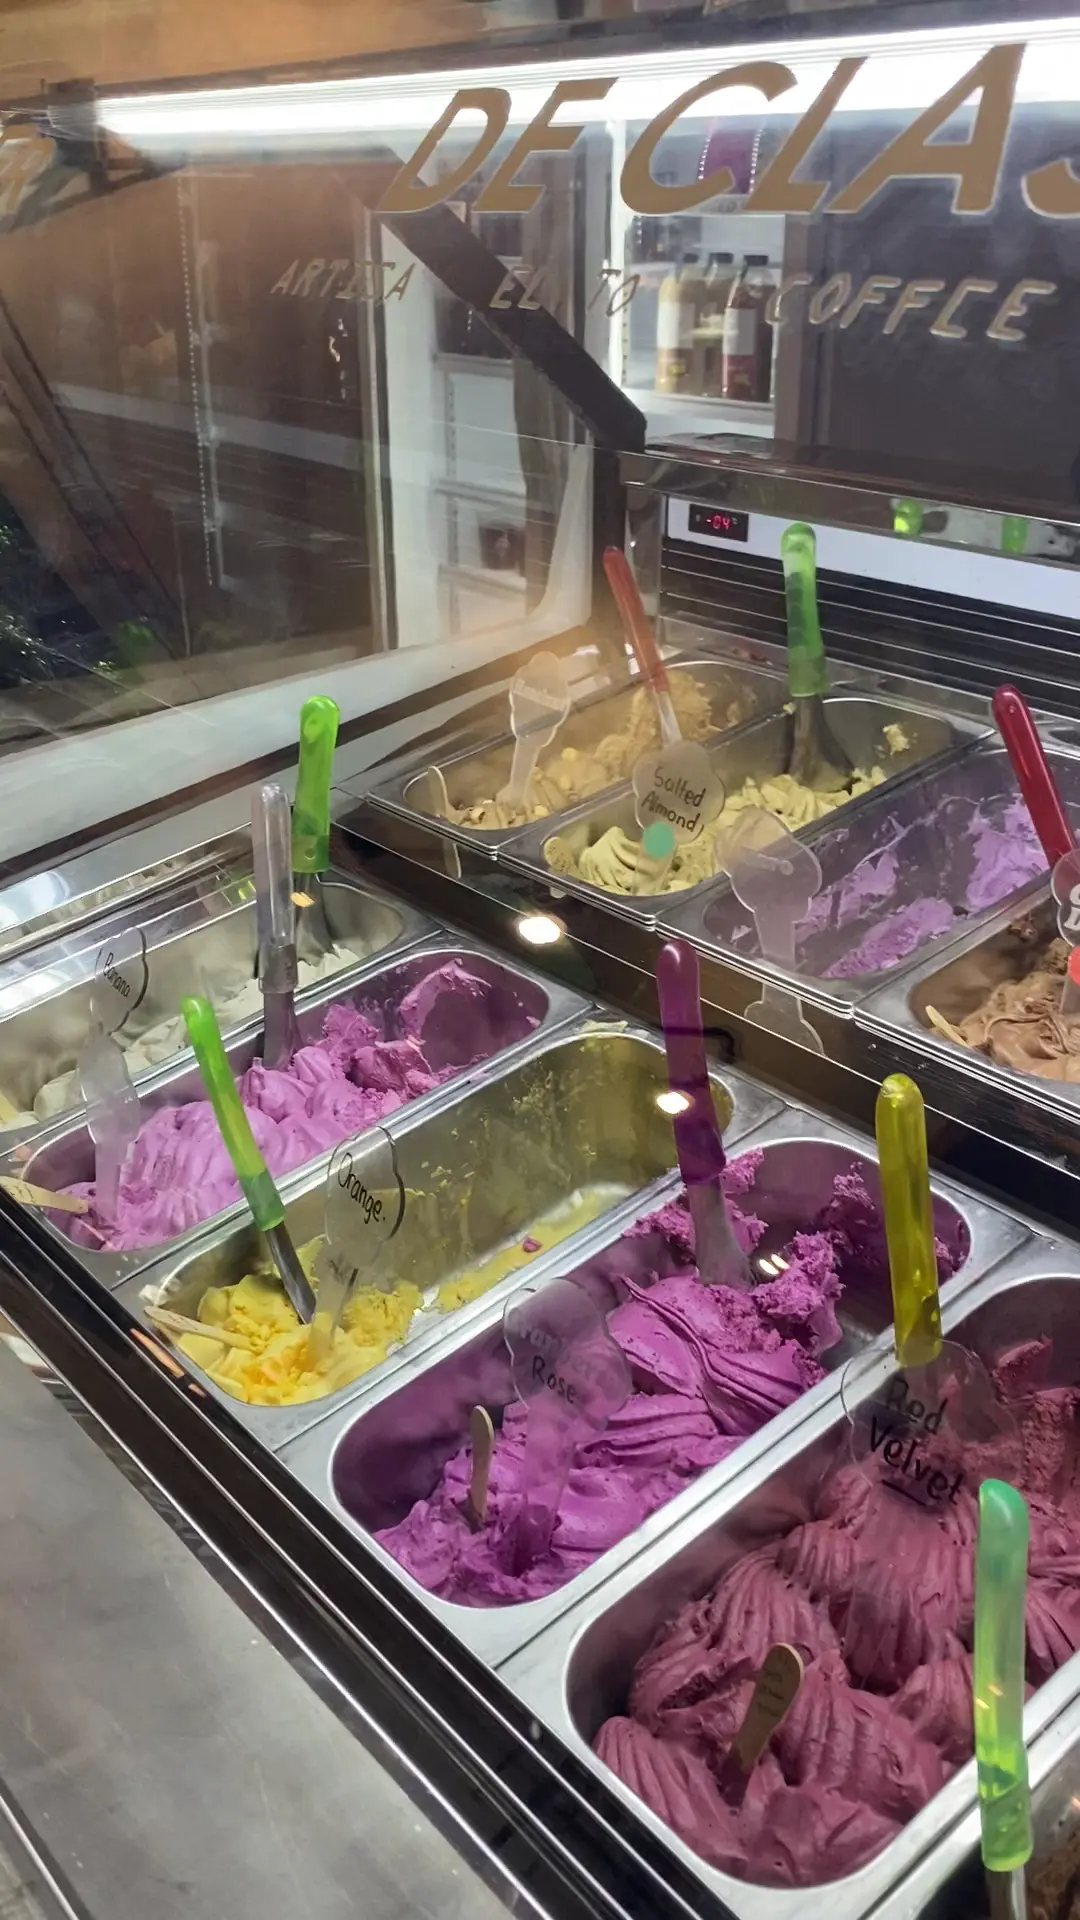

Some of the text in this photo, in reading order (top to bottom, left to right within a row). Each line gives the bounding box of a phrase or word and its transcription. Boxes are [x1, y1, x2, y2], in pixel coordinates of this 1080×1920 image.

[375, 77, 620, 214] DE
[640, 789, 702, 833] Almond
[653, 765, 707, 808] Salted
[102, 951, 131, 998] Banana
[531, 1355, 578, 1405] Rose
[886, 1376, 949, 1436] Red
[868, 1415, 966, 1506] Velvet
